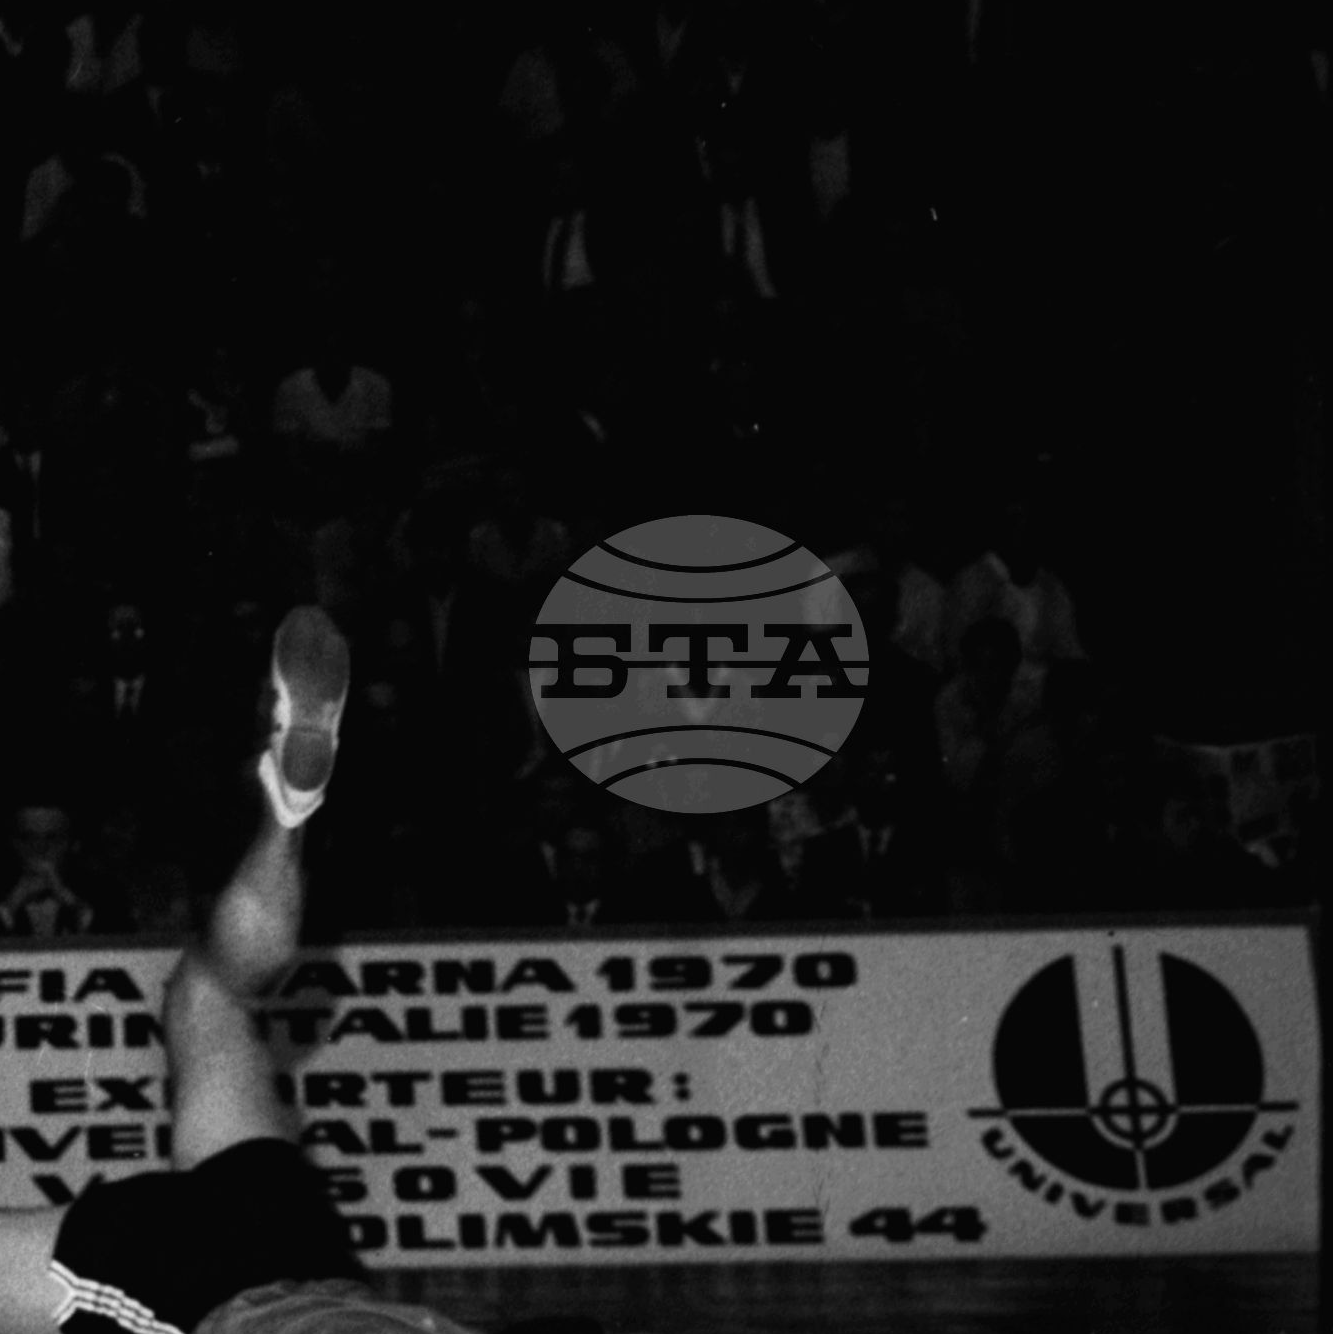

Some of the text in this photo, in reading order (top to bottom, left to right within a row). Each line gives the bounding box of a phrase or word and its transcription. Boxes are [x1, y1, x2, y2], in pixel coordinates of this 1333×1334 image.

[254, 958, 574, 998] ARNA
[595, 952, 857, 992] 1970
[565, 1000, 813, 1040] 1970
[29, 1069, 691, 1114] EXRTEUR:
[848, 1206, 988, 1243] 44
